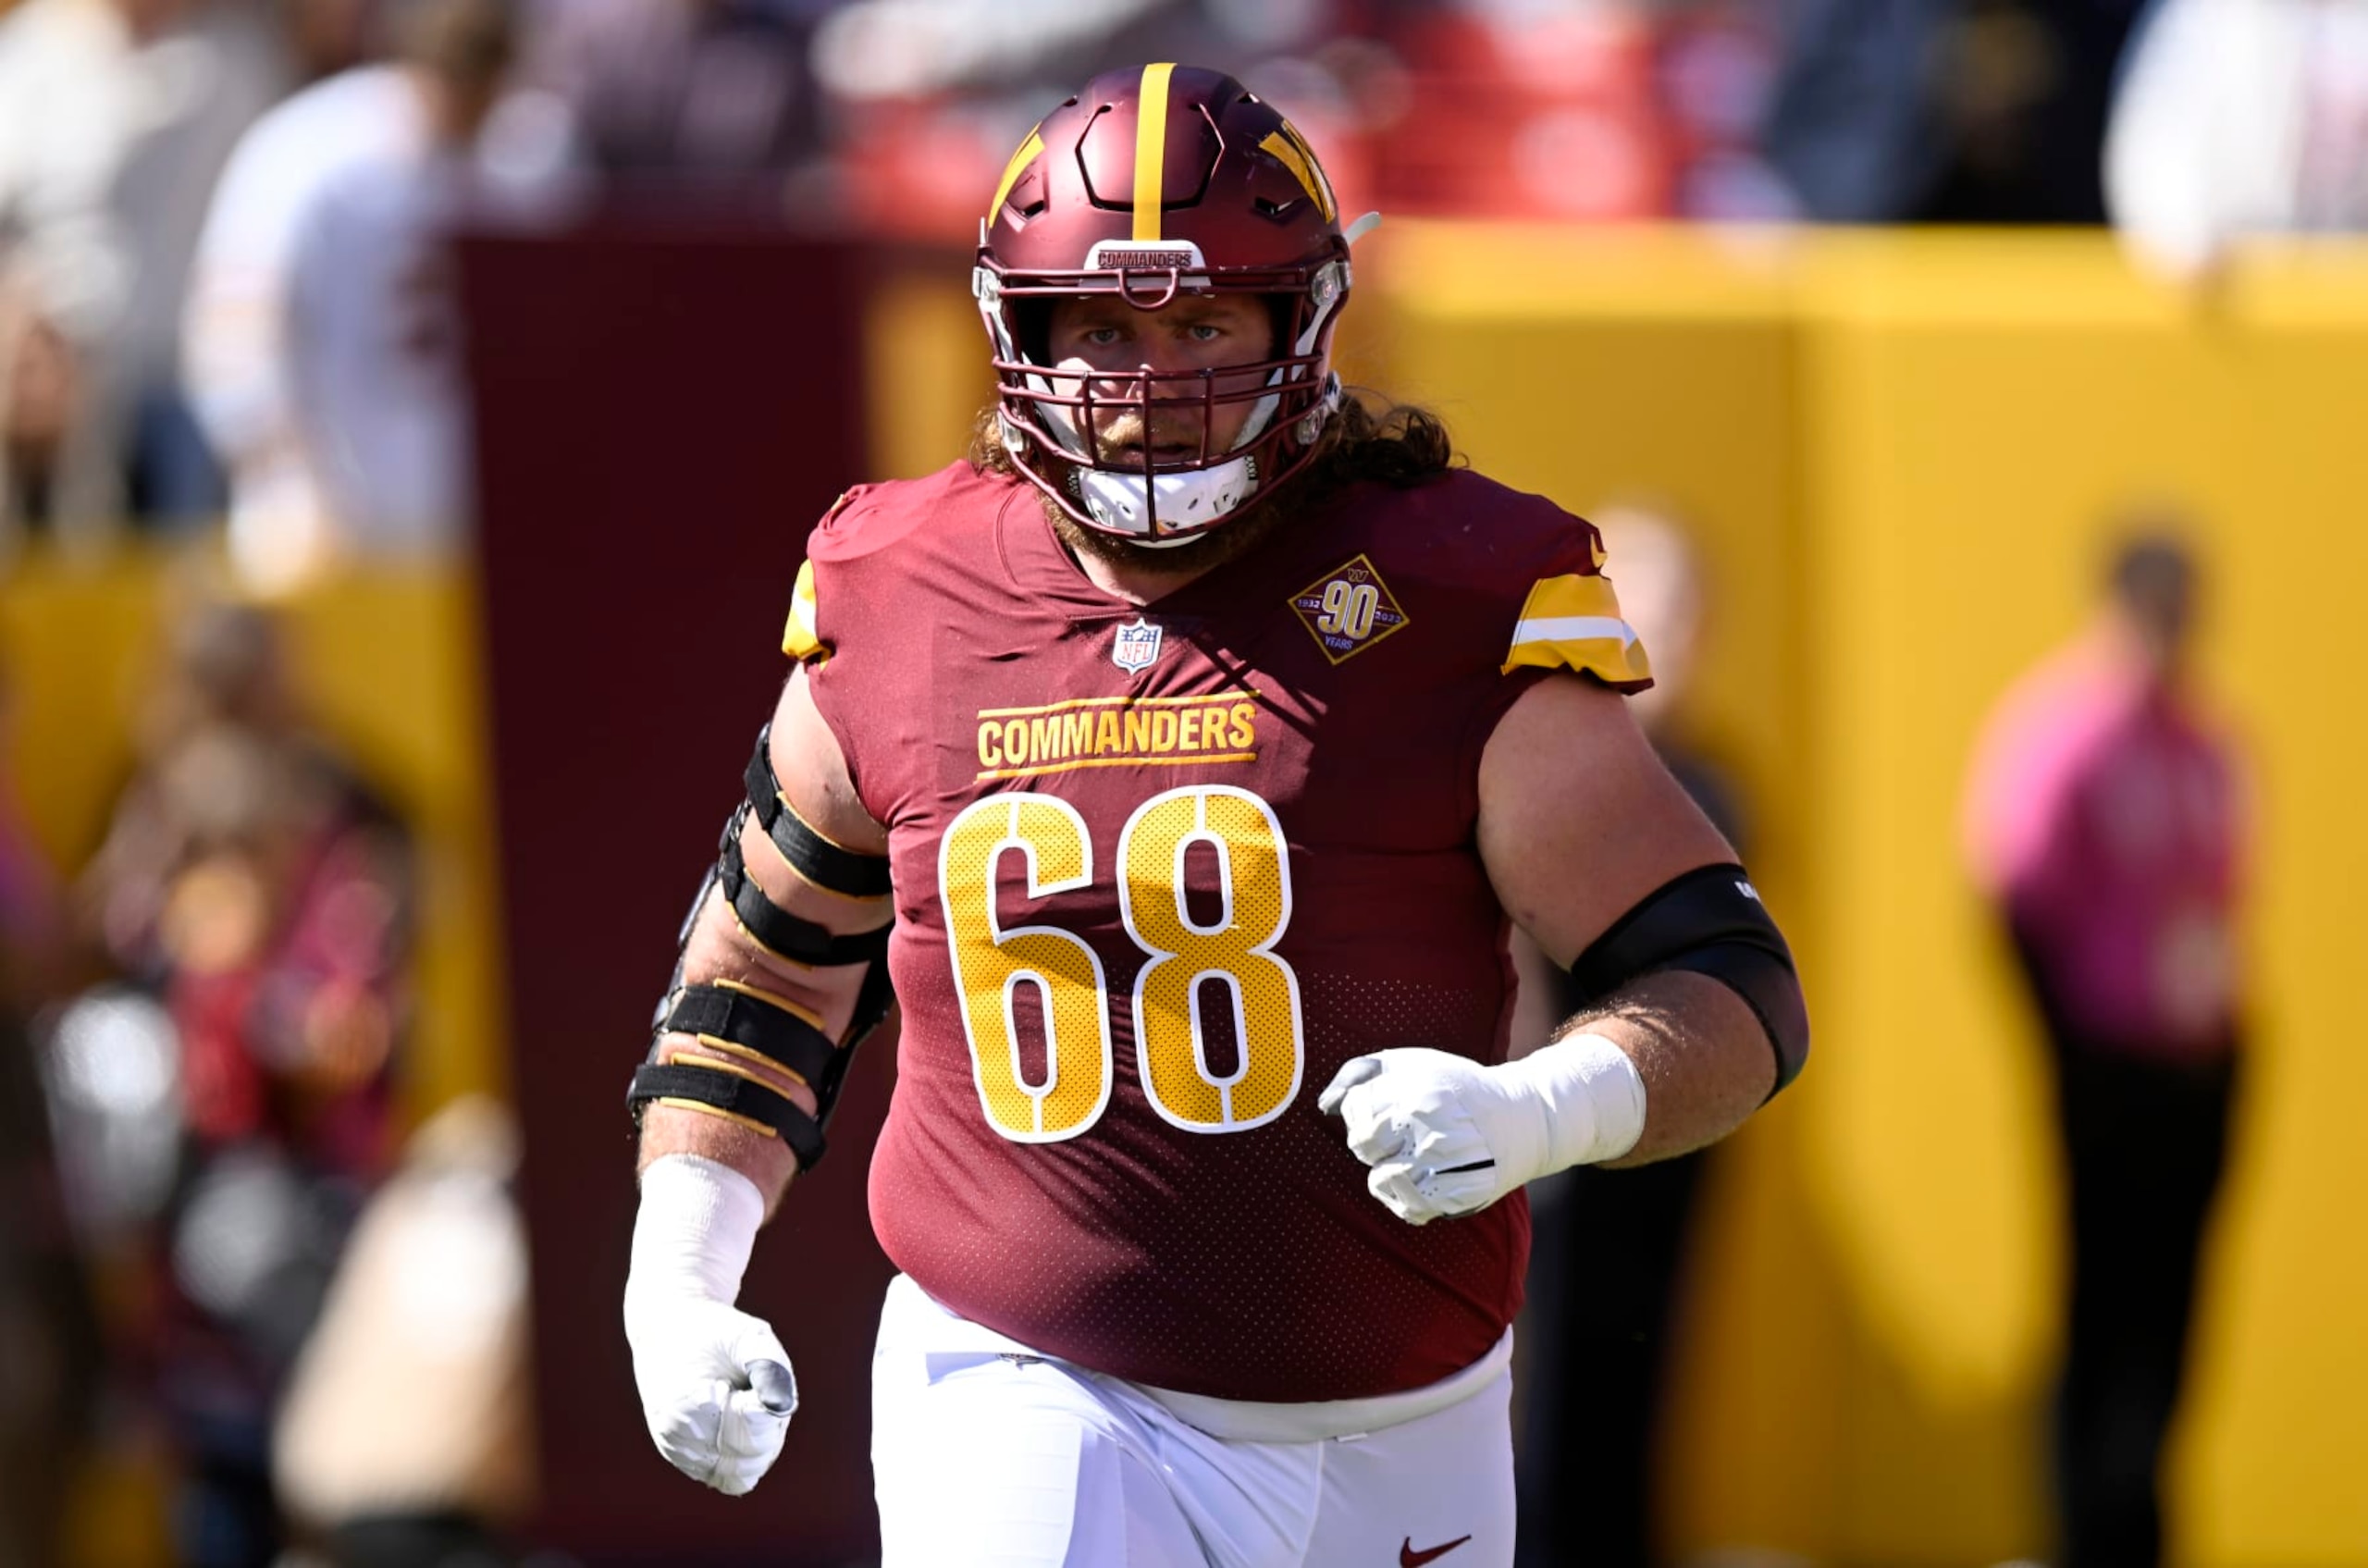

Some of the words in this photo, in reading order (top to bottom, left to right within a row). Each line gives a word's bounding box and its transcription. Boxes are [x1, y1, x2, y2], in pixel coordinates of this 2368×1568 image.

[1098, 253, 1192, 267] COMMANDERS
[1298, 599, 1320, 609] 1932
[1318, 581, 1378, 638] 90
[1375, 612, 1400, 623] 2022
[1326, 636, 1352, 649] YEARS
[1122, 643, 1150, 662] NFL
[977, 703, 1256, 767] COMMANDERS
[938, 784, 1304, 1143] 68
